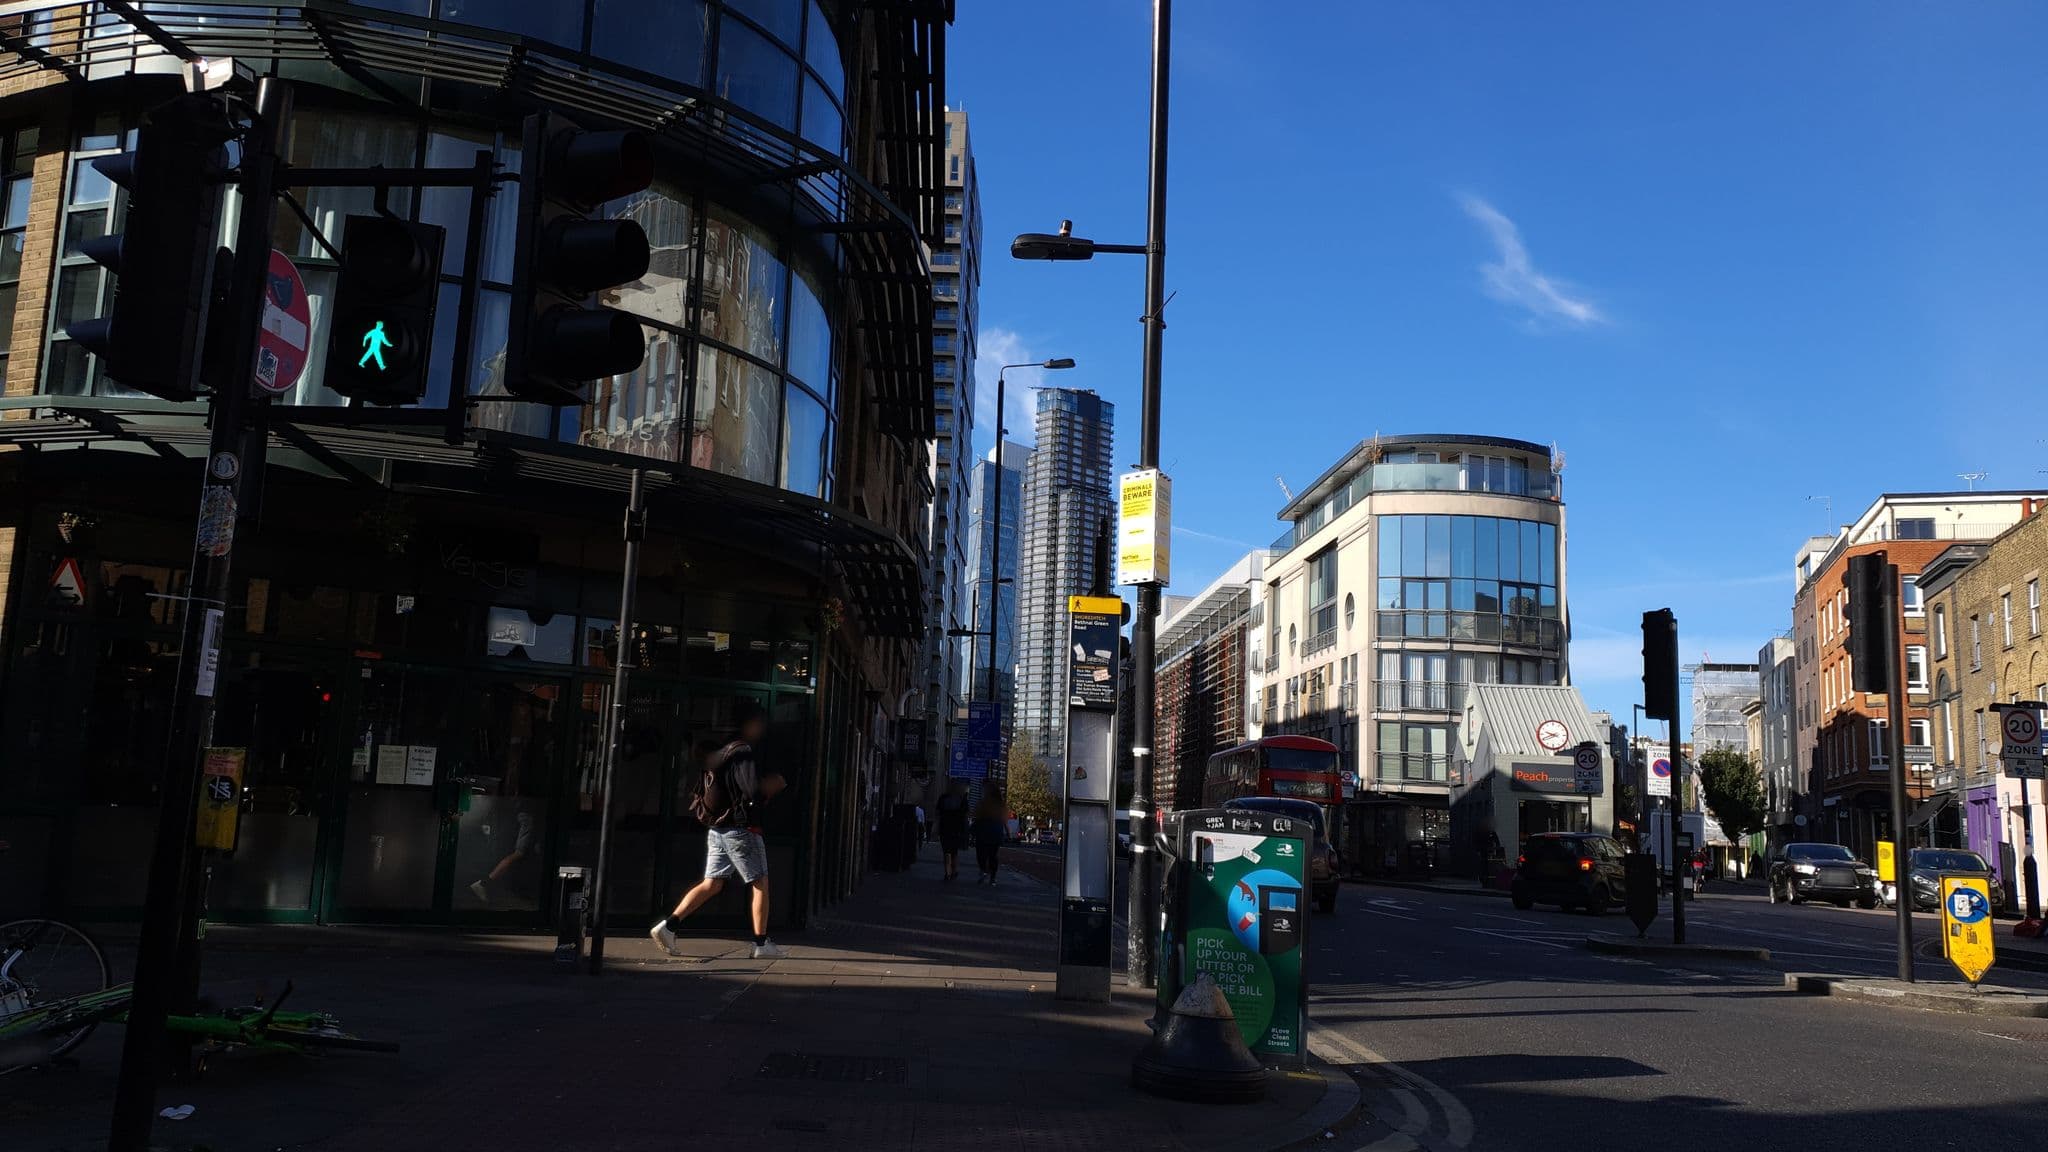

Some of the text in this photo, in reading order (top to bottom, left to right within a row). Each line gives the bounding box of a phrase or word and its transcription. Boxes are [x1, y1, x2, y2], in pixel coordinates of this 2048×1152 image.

[1123, 483, 1152, 493] CRIMINALS
[1123, 489, 1152, 501] BEWARE
[2009, 719, 2033, 733] 20
[2007, 745, 2038, 754] ZONE
[1580, 754, 1596, 763] 20
[1516, 770, 1549, 781] Peach
[1577, 770, 1600, 778] ZONE
[1206, 816, 1223, 824] GREY
[1197, 938, 1224, 950] PICK
[1197, 949, 1248, 962] UP YOUR
[1196, 960, 1255, 973] LITTER OR
[1218, 972, 1246, 984] PICK
[1239, 985, 1263, 996] BILL
